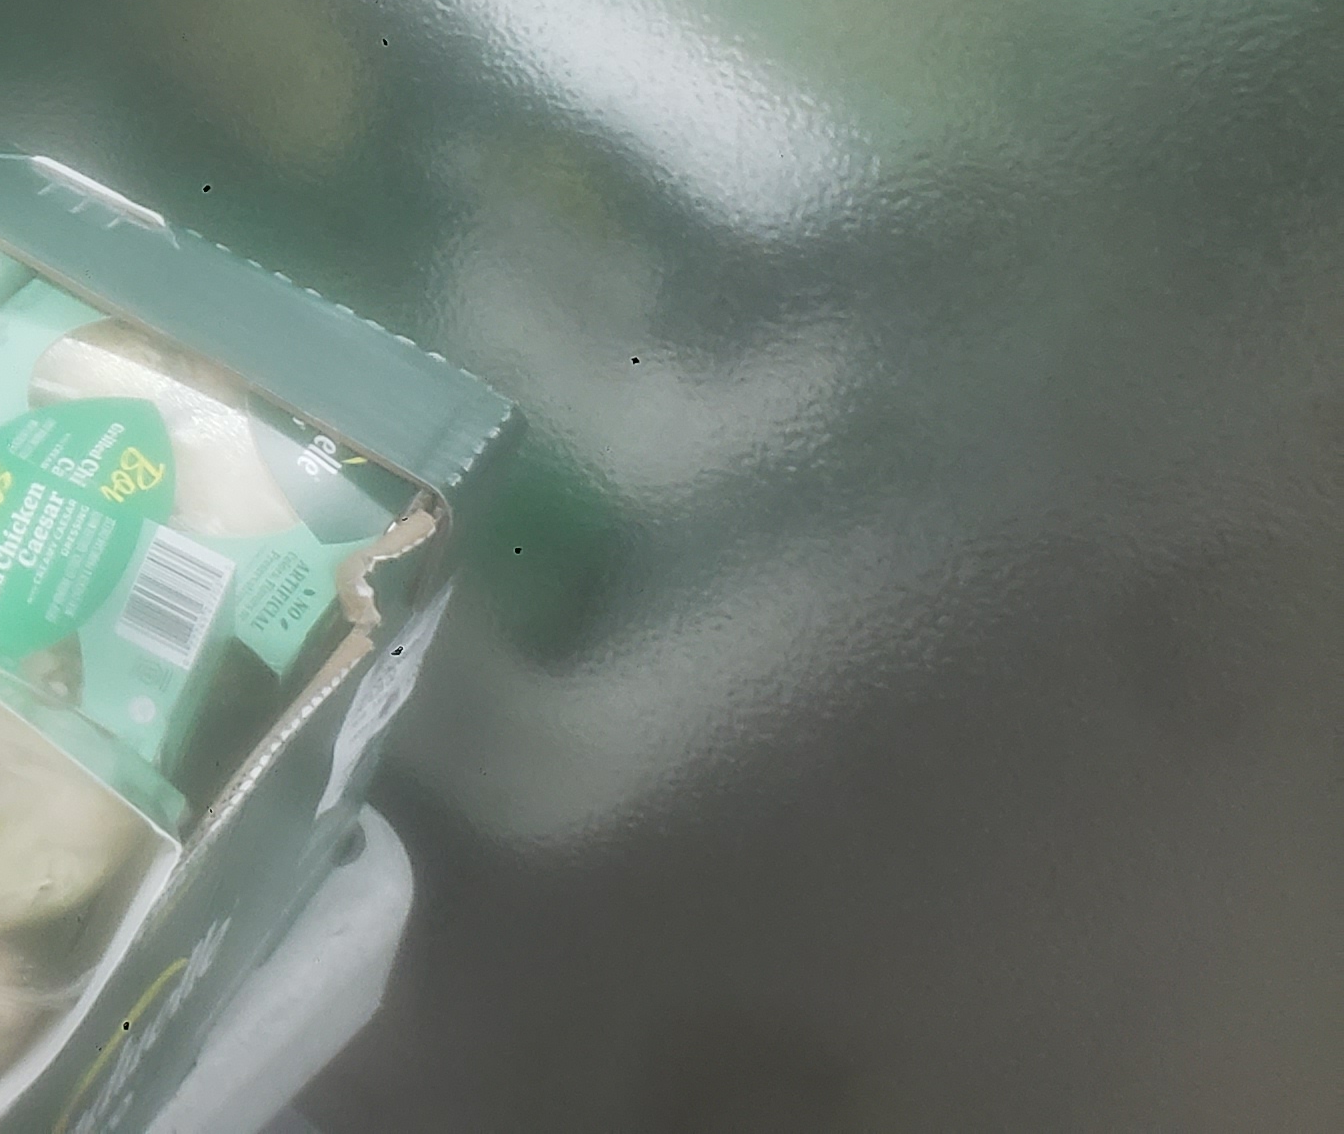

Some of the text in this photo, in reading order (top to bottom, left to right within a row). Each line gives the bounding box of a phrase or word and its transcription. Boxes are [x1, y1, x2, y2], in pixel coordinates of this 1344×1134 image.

[89, 422, 125, 461] Grilled
[18, 490, 65, 567] Caesar
[33, 541, 58, 585] CREAMY
[53, 498, 78, 541] CAESAR
[61, 505, 91, 558] DRESSING
[250, 558, 310, 631] ARTIFICIAL
[287, 597, 310, 621] NO
